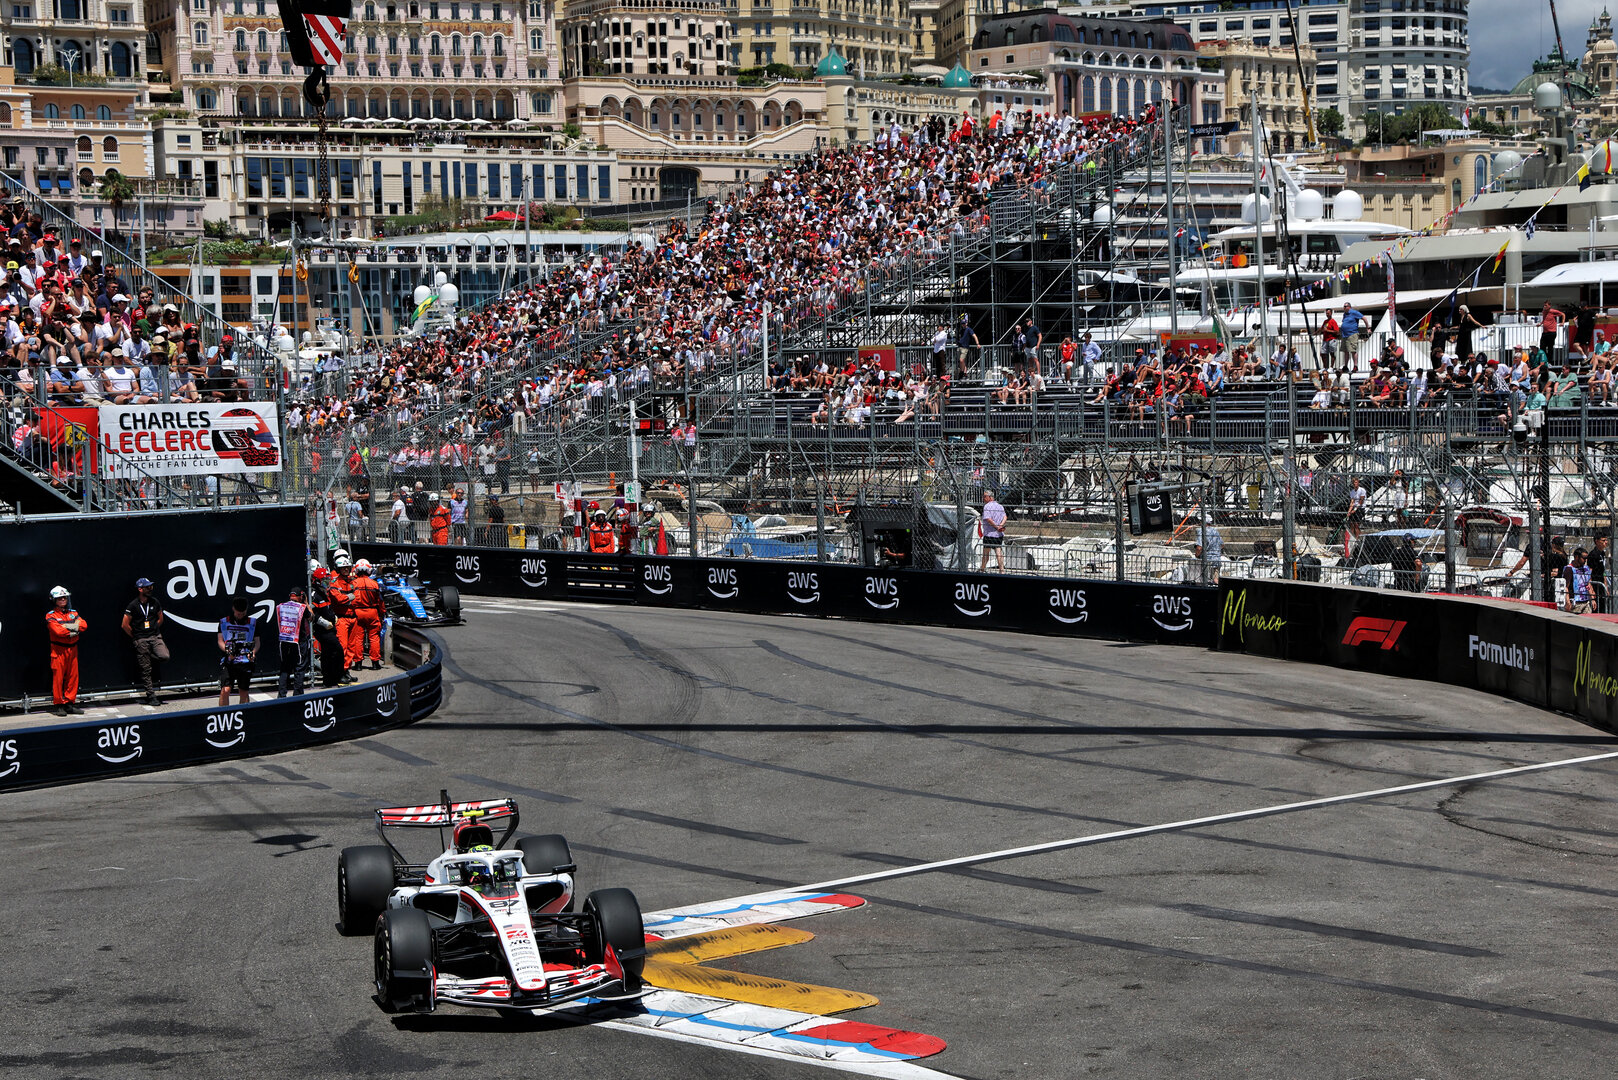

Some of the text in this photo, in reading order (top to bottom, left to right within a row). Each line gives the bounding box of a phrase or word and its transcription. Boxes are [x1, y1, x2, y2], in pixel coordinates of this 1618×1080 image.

[119, 411, 211, 430] CHARLES
[104, 430, 212, 454] LECLERC
[156, 453, 206, 461] OFFICIAL
[395, 552, 418, 567] aws
[456, 555, 480, 571] aws
[521, 558, 547, 574] aws
[167, 555, 270, 599] aws
[644, 565, 672, 581] aws
[708, 567, 738, 585] aws
[788, 572, 819, 589] aws
[865, 577, 898, 595] aws
[955, 583, 990, 601] aws
[1049, 588, 1087, 608] aws
[1153, 595, 1192, 615] aws
[1222, 588, 1287, 643] Monaco
[1341, 616, 1408, 650] F1
[377, 684, 397, 704] aws
[304, 697, 334, 718] aws
[206, 711, 244, 733] aws
[97, 724, 141, 748] aws
